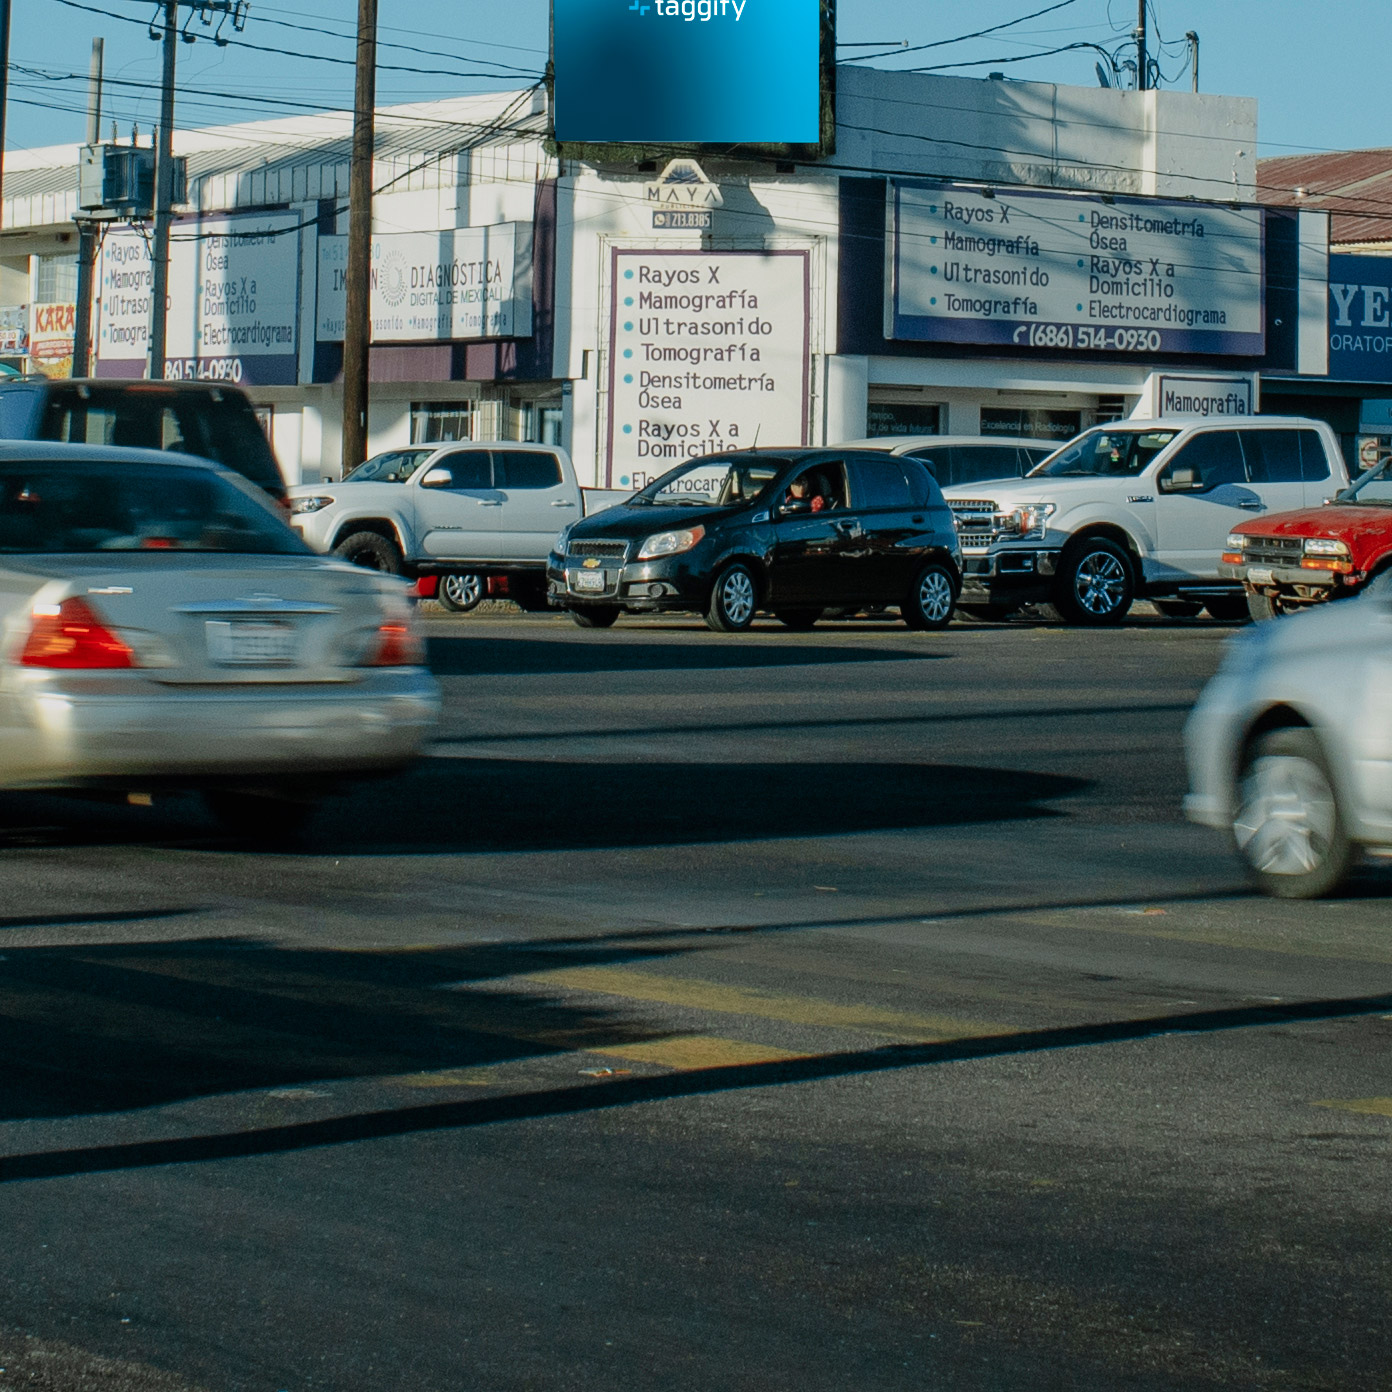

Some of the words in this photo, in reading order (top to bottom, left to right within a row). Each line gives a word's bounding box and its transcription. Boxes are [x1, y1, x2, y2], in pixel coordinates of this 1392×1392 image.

[648, 187, 718, 202] MAYA
[944, 201, 994, 225] Rayos
[1000, 205, 1010, 224] X
[1090, 210, 1205, 237] Densitometría
[944, 230, 1039, 256] Mamografía
[1090, 228, 1127, 251] Ósea
[110, 242, 141, 265] Rayos
[206, 249, 229, 272] Ósea
[411, 258, 502, 289] DIAGNÓSTICA
[639, 265, 700, 287] Rayos
[708, 265, 720, 284] X
[944, 261, 1049, 287] Ultrasonido
[1090, 255, 1143, 278] Rayos
[1149, 258, 1159, 277] X
[1166, 264, 1175, 277] a
[109, 268, 152, 291] Mamogra
[204, 279, 237, 300] Rayos
[240, 276, 247, 296] X
[250, 280, 257, 295] a
[1089, 275, 1174, 298] Domicilio
[204, 293, 256, 316] Domicilio
[410, 291, 444, 306] DIGITAL
[446, 289, 459, 304] DE
[461, 287, 503, 303] MEXICALI
[639, 289, 758, 312] Mamografía
[944, 293, 1038, 316] Tomografía
[35, 303, 75, 333] KARA
[1089, 299, 1227, 326] Electrocardiograma
[108, 322, 147, 346] Tomogra
[203, 319, 293, 347] Electrocardiograma
[639, 316, 773, 336] Ultrasonido
[1029, 323, 1074, 348] (686)
[1076, 327, 1161, 352] 514-0930
[641, 342, 761, 365] Tomografía
[639, 370, 775, 392] Densitometría
[638, 388, 682, 409] Ósea
[638, 419, 701, 442] Rayos
[709, 419, 720, 437] X
[729, 423, 739, 437] a
